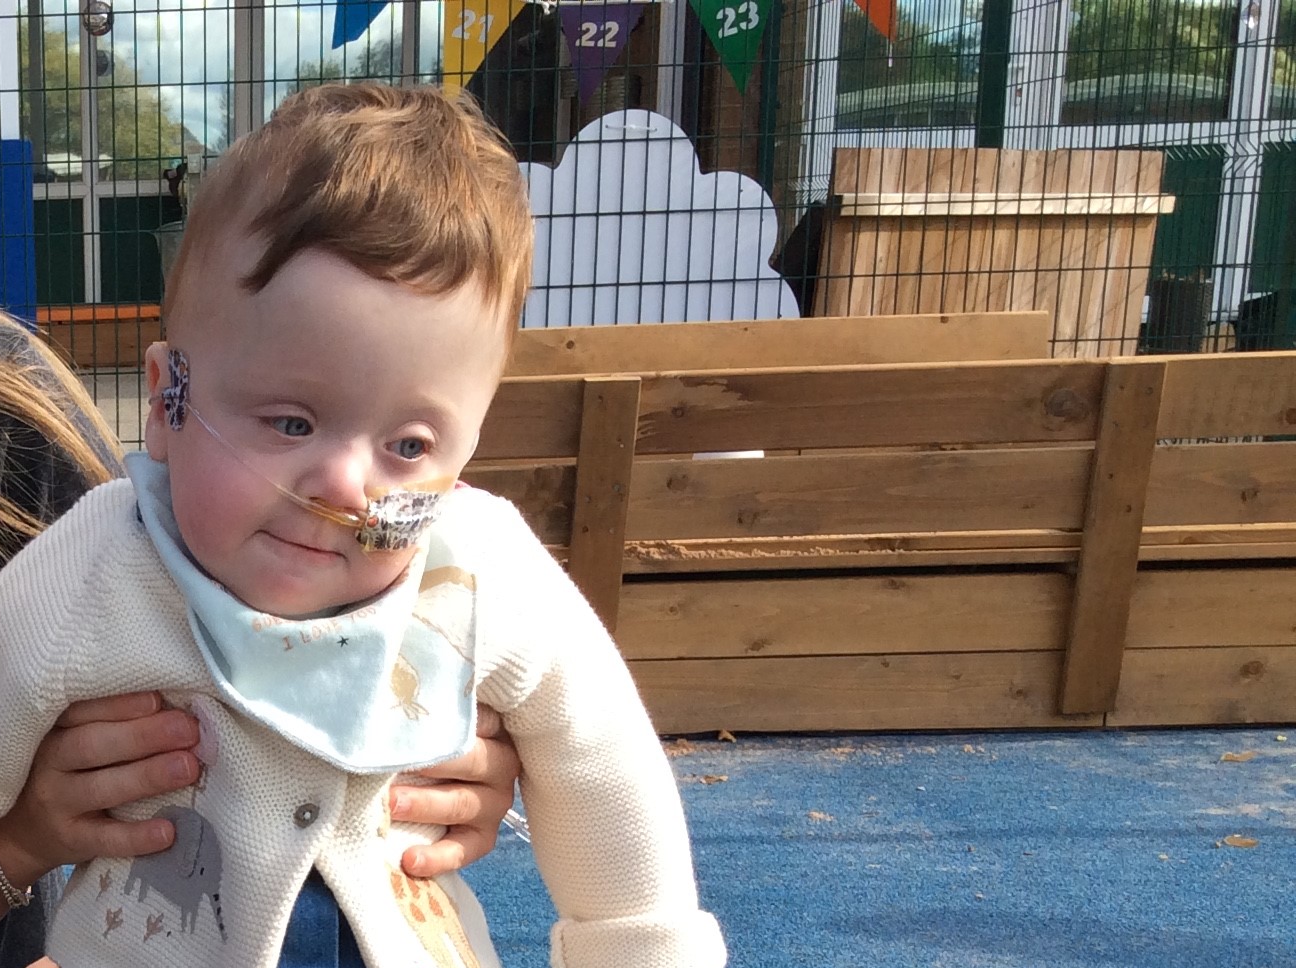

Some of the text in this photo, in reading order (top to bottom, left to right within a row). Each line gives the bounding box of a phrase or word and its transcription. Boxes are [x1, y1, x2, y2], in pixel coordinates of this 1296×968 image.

[452, 9, 494, 43] 21
[575, 21, 620, 48] 22
[716, 1, 760, 39] 23
